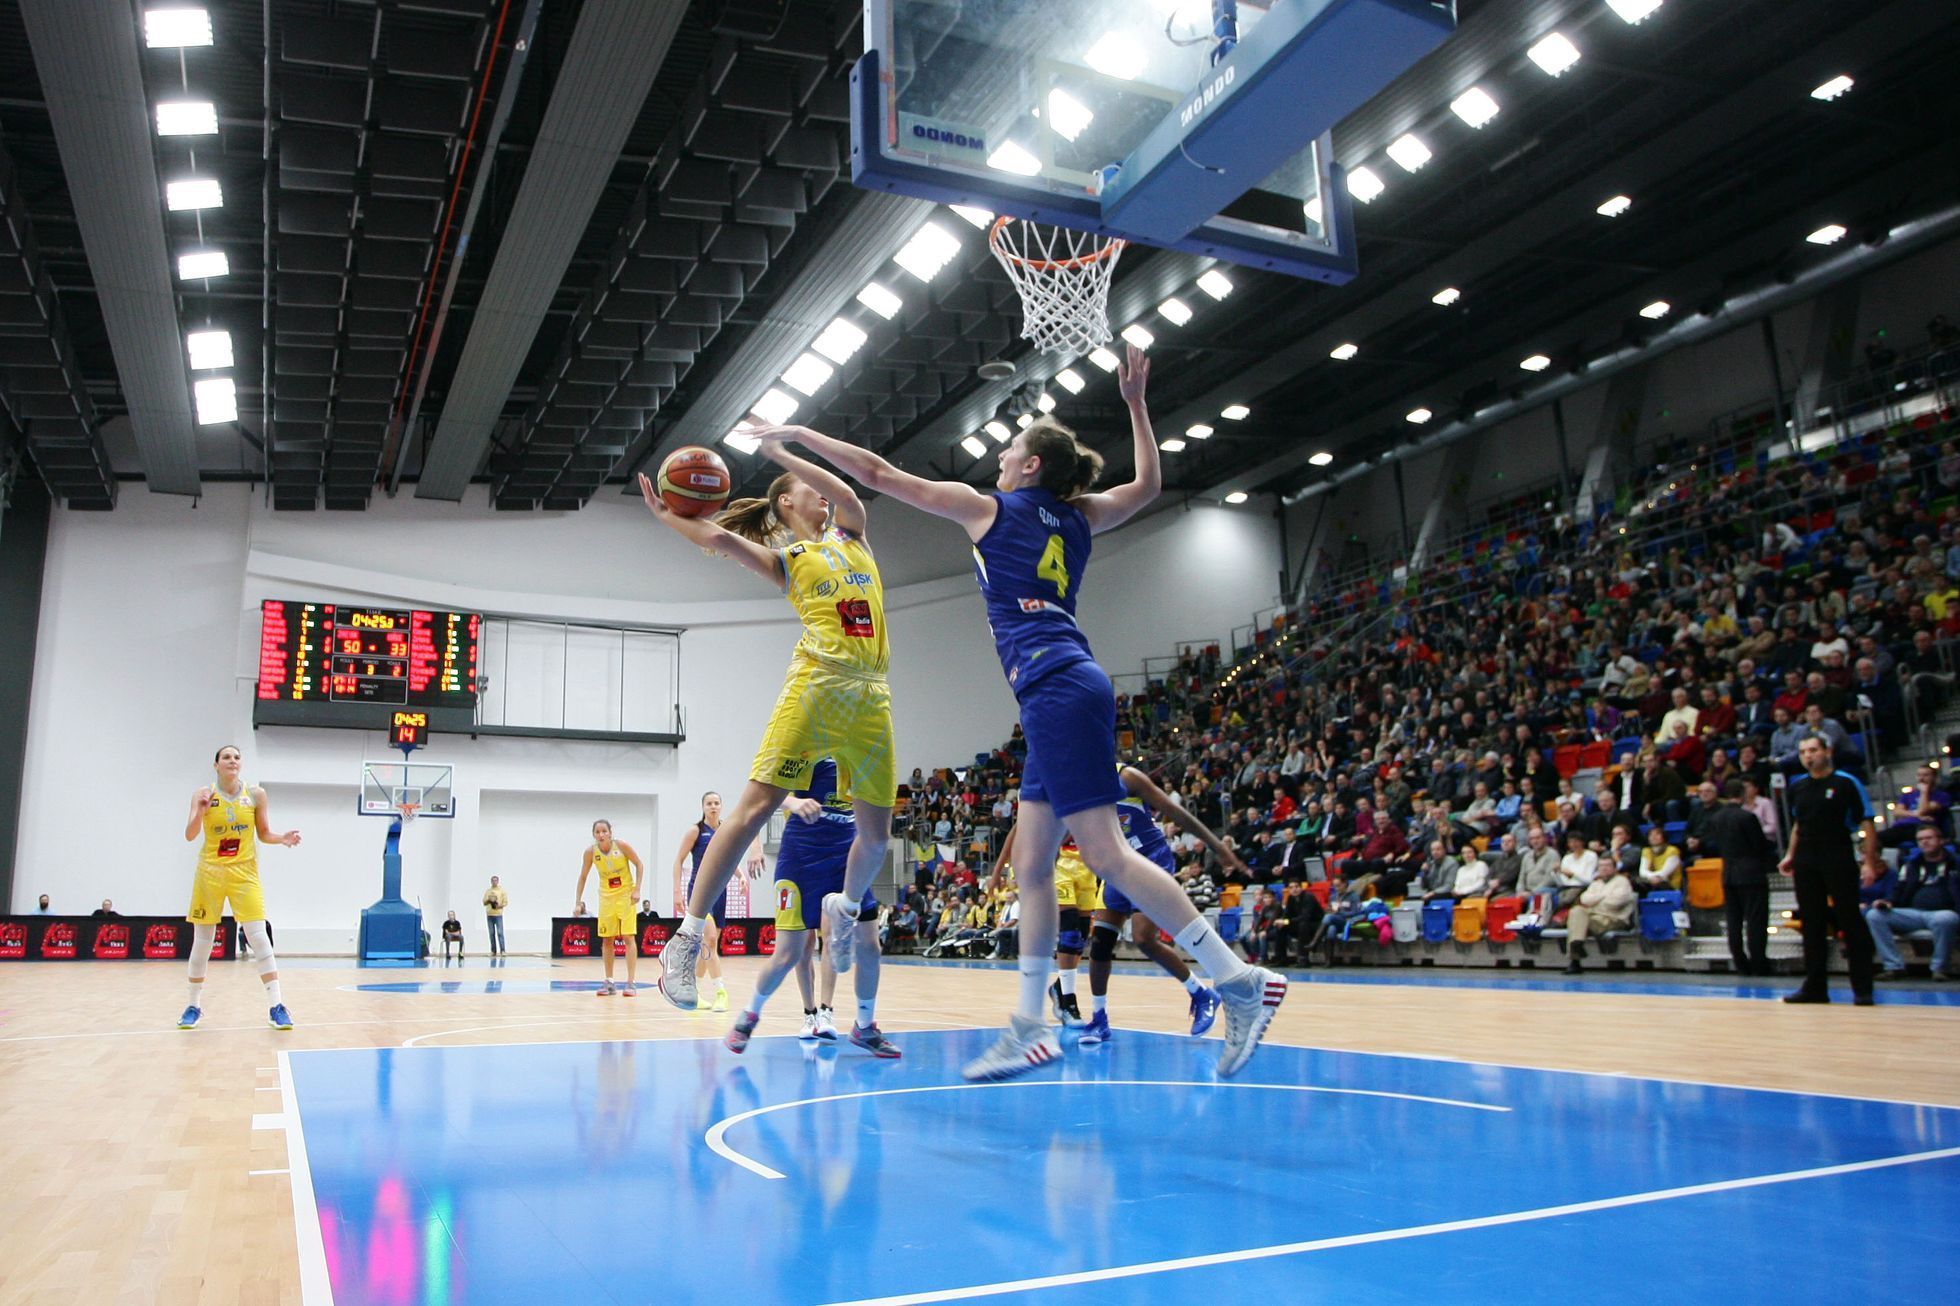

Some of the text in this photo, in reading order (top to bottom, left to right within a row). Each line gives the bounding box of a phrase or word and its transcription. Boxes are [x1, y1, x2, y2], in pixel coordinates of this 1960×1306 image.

[1180, 65, 1236, 127] MONDO
[1037, 533, 1069, 600] 4
[343, 640, 361, 653] 50
[391, 643, 407, 656] 33
[394, 712, 426, 727] 04:25
[399, 727, 415, 743] 14
